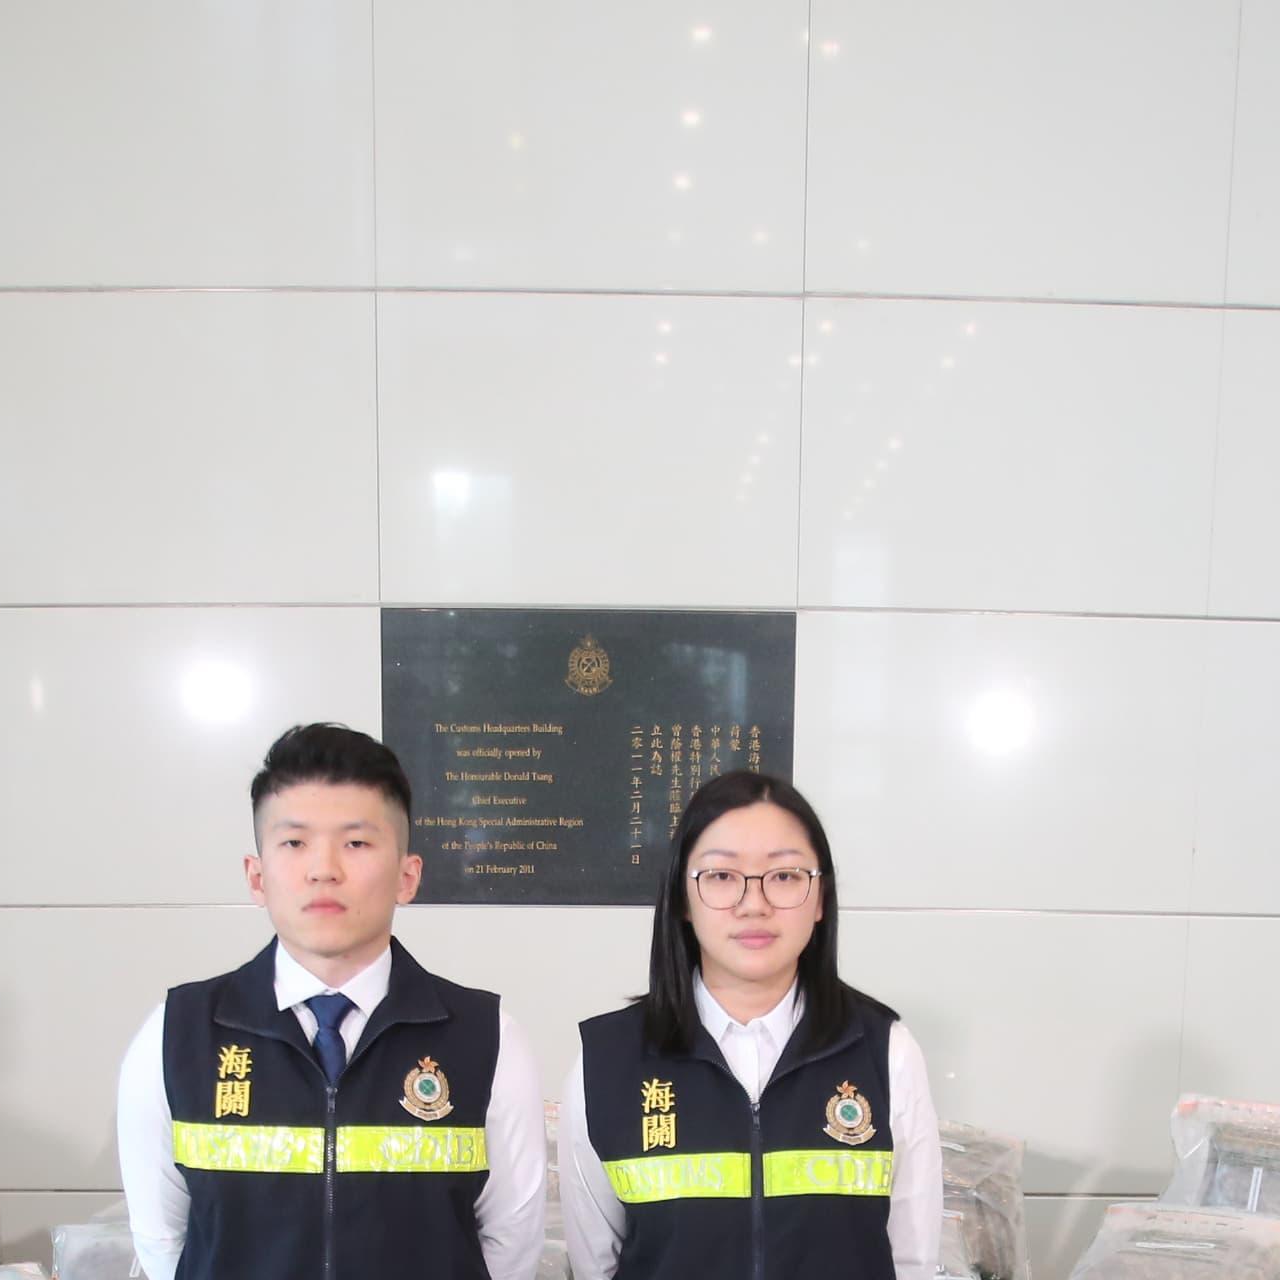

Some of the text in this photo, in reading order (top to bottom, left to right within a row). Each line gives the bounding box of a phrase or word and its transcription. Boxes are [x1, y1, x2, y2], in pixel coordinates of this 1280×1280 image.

[434, 723, 564, 735] The Customs Headquarters Building
[456, 747, 542, 759] was officially opened by
[445, 772, 553, 784] The Honourable Donald Tsang
[472, 796, 527, 805] Chief Executive
[630, 726, 644, 865] 二零一一年二月二十一日
[424, 817, 435, 826] the
[437, 817, 456, 828] Hong
[459, 817, 478, 828] Kong
[480, 817, 503, 828] Special
[505, 817, 557, 826] Administrative
[559, 817, 584, 828] Region
[536, 841, 557, 850] China
[486, 865, 518, 876] February
[215, 1045, 252, 1119] 海關
[642, 1078, 677, 1151] 海關
